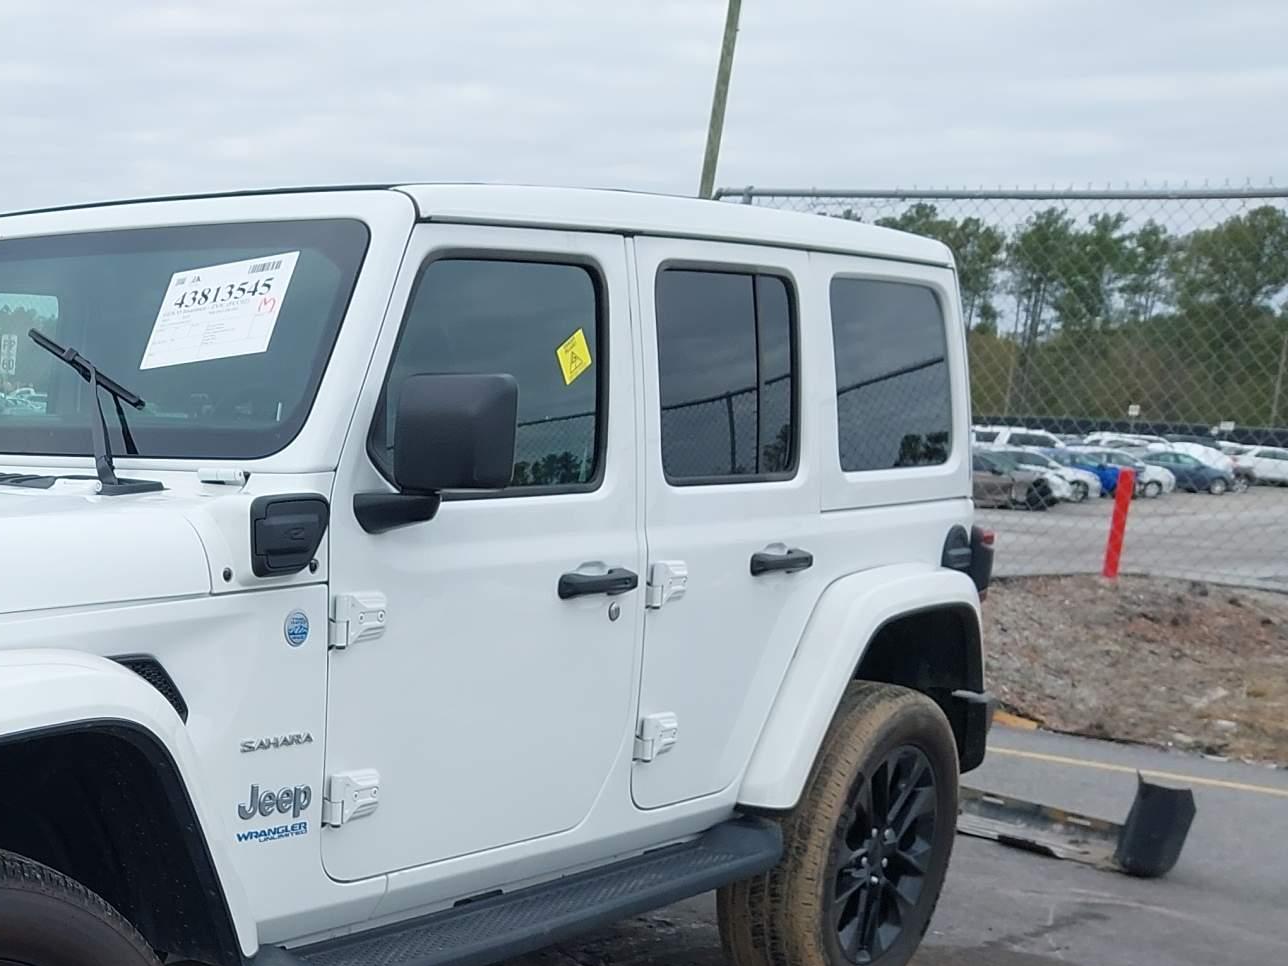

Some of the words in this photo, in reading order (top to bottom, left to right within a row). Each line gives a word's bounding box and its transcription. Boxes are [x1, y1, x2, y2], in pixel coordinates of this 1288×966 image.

[174, 277, 274, 308] 43813545
[240, 732, 313, 753] SAHARA
[238, 784, 312, 820] Jeep
[236, 821, 308, 842] WRANGLER
[258, 829, 308, 843] UNLIMITED
